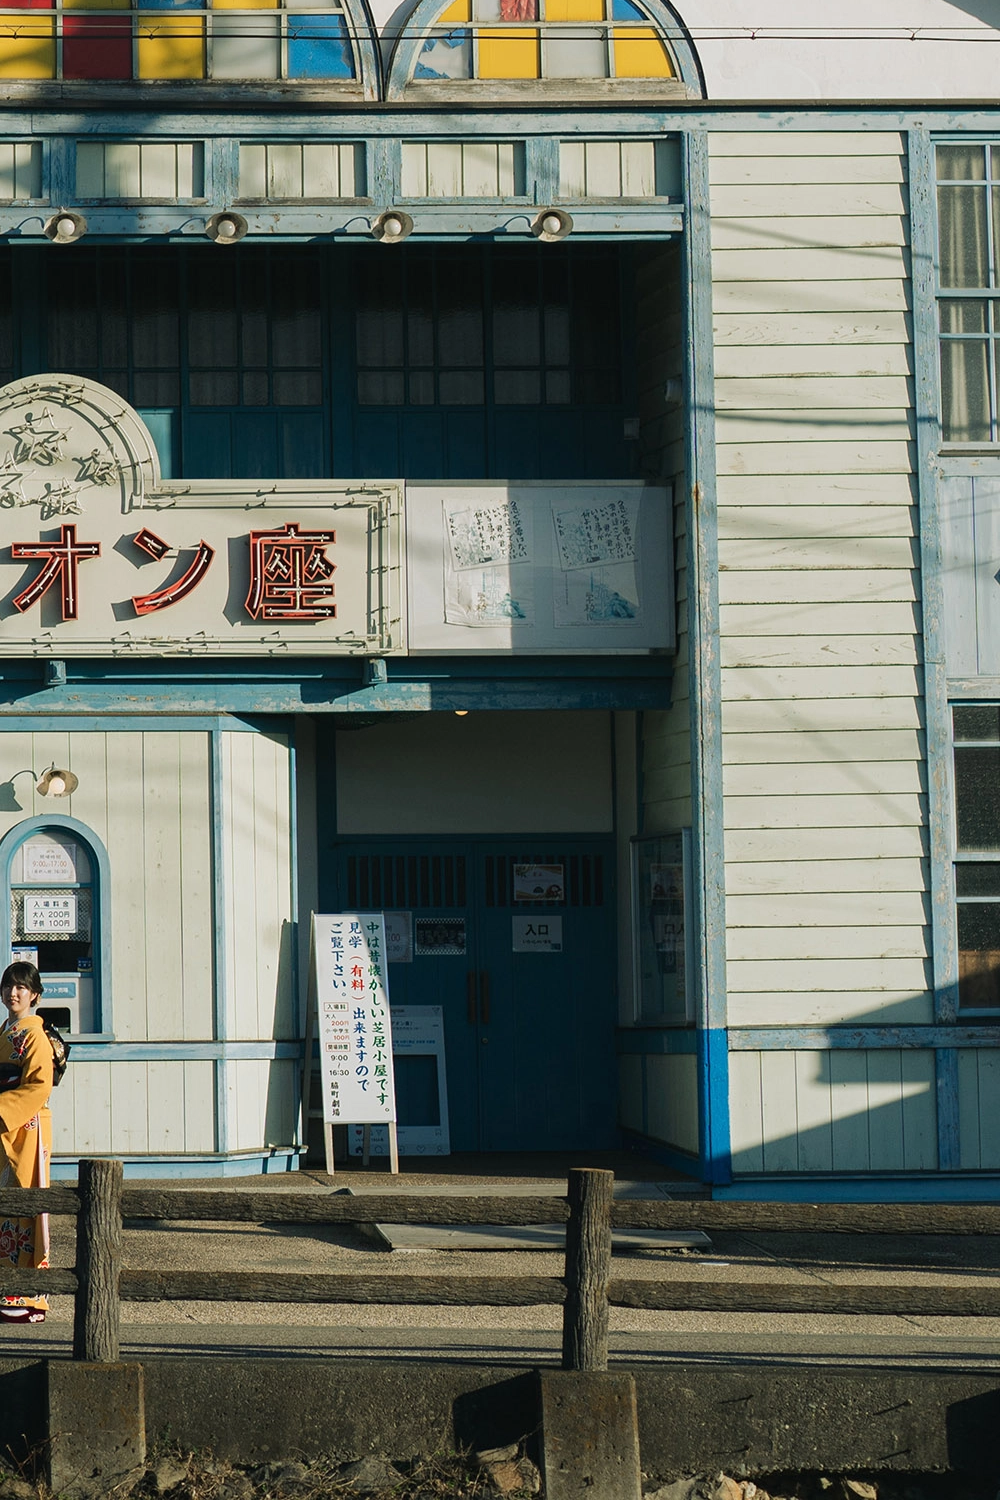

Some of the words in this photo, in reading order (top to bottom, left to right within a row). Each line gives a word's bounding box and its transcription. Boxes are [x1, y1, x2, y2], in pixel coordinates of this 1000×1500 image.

[526, 924, 549, 936] 入口
[330, 921, 347, 997] ご覧下さい。
[330, 1053, 348, 1062] 9:00
[329, 1069, 350, 1077] 16:30
